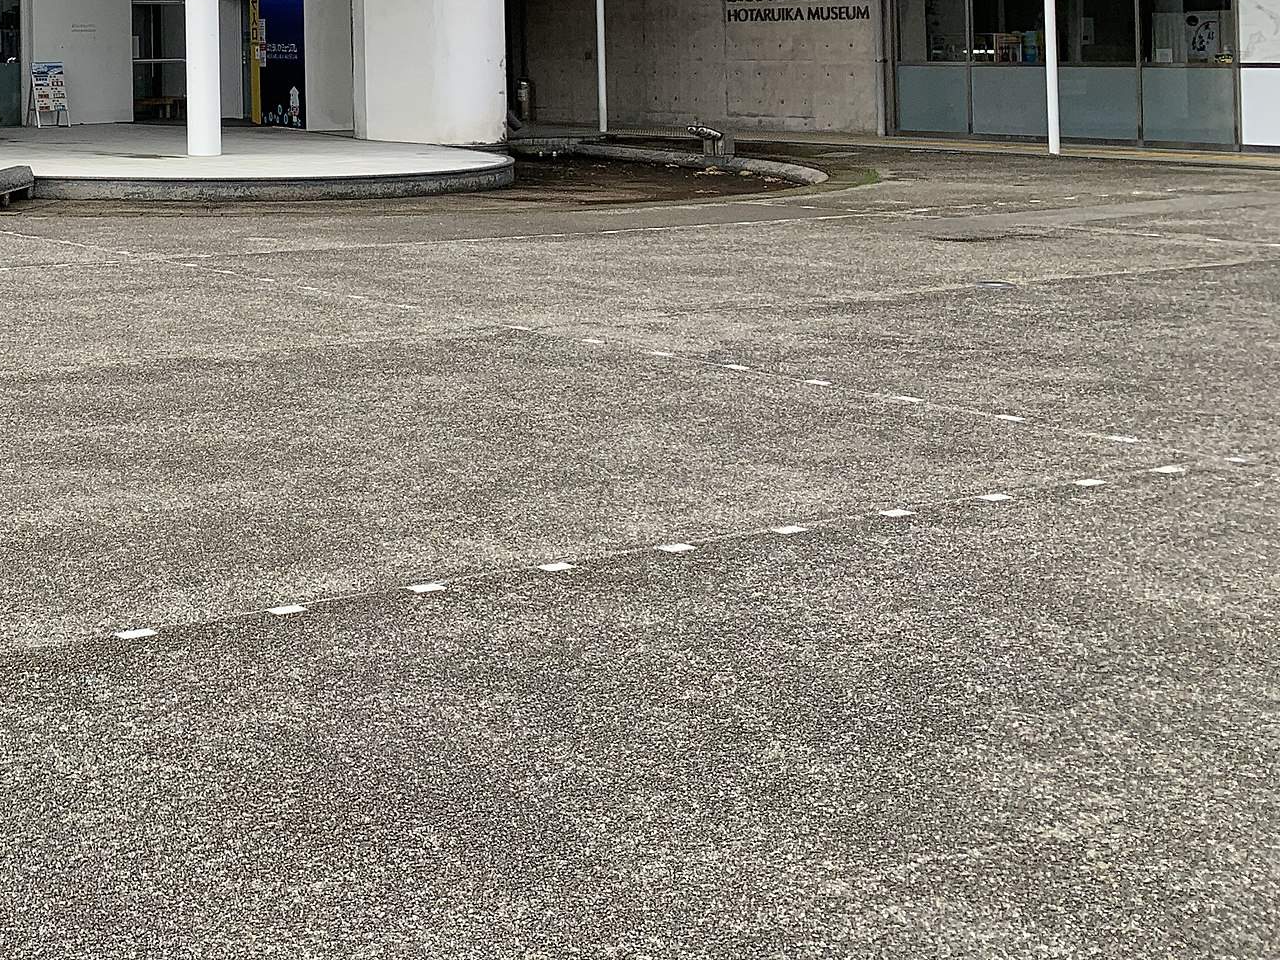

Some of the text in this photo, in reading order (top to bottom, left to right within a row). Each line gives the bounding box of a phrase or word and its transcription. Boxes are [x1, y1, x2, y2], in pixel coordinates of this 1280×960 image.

[727, 5, 870, 22] HOTARUIKA MUSEUM
[251, 12, 258, 41] 入口
